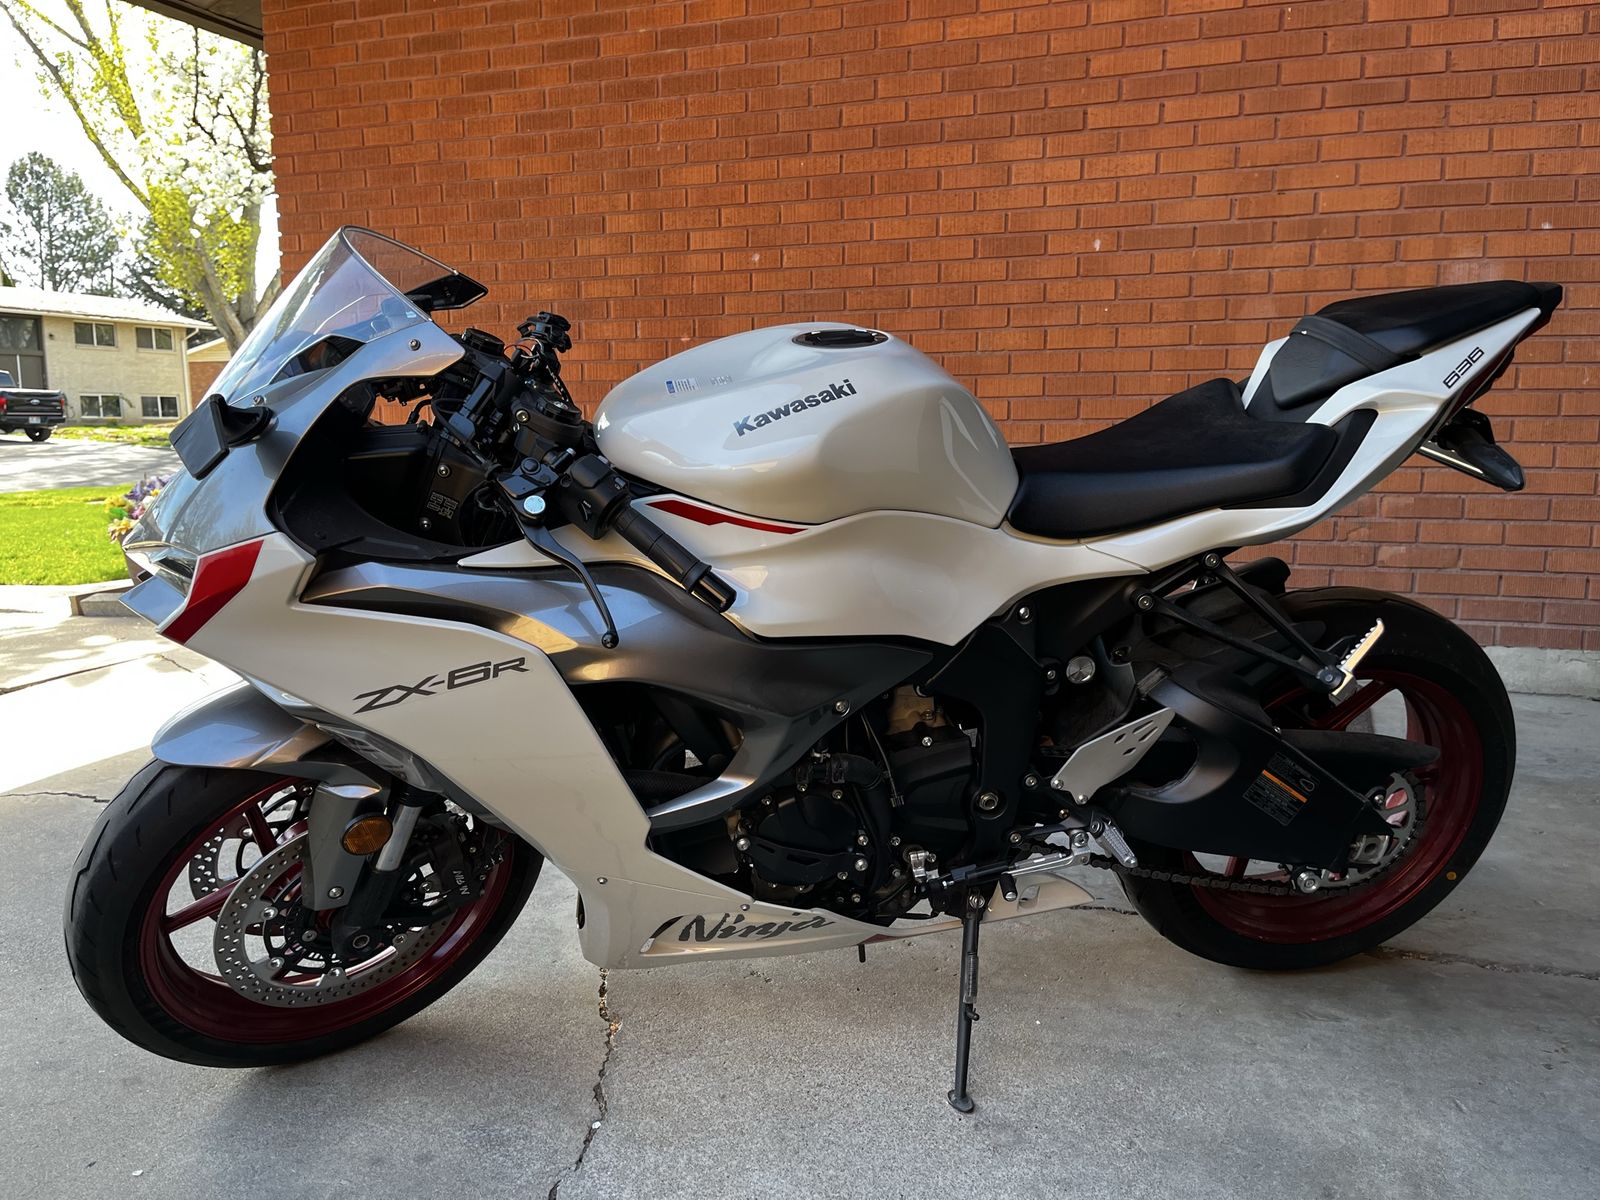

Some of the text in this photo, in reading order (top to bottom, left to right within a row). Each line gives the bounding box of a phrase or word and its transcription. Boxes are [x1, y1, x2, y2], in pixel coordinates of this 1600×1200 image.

[1442, 346, 1485, 389] 636
[733, 378, 857, 437] Kawasaki
[352, 656, 530, 715] ZX-6R
[678, 912, 835, 942] Ninja
